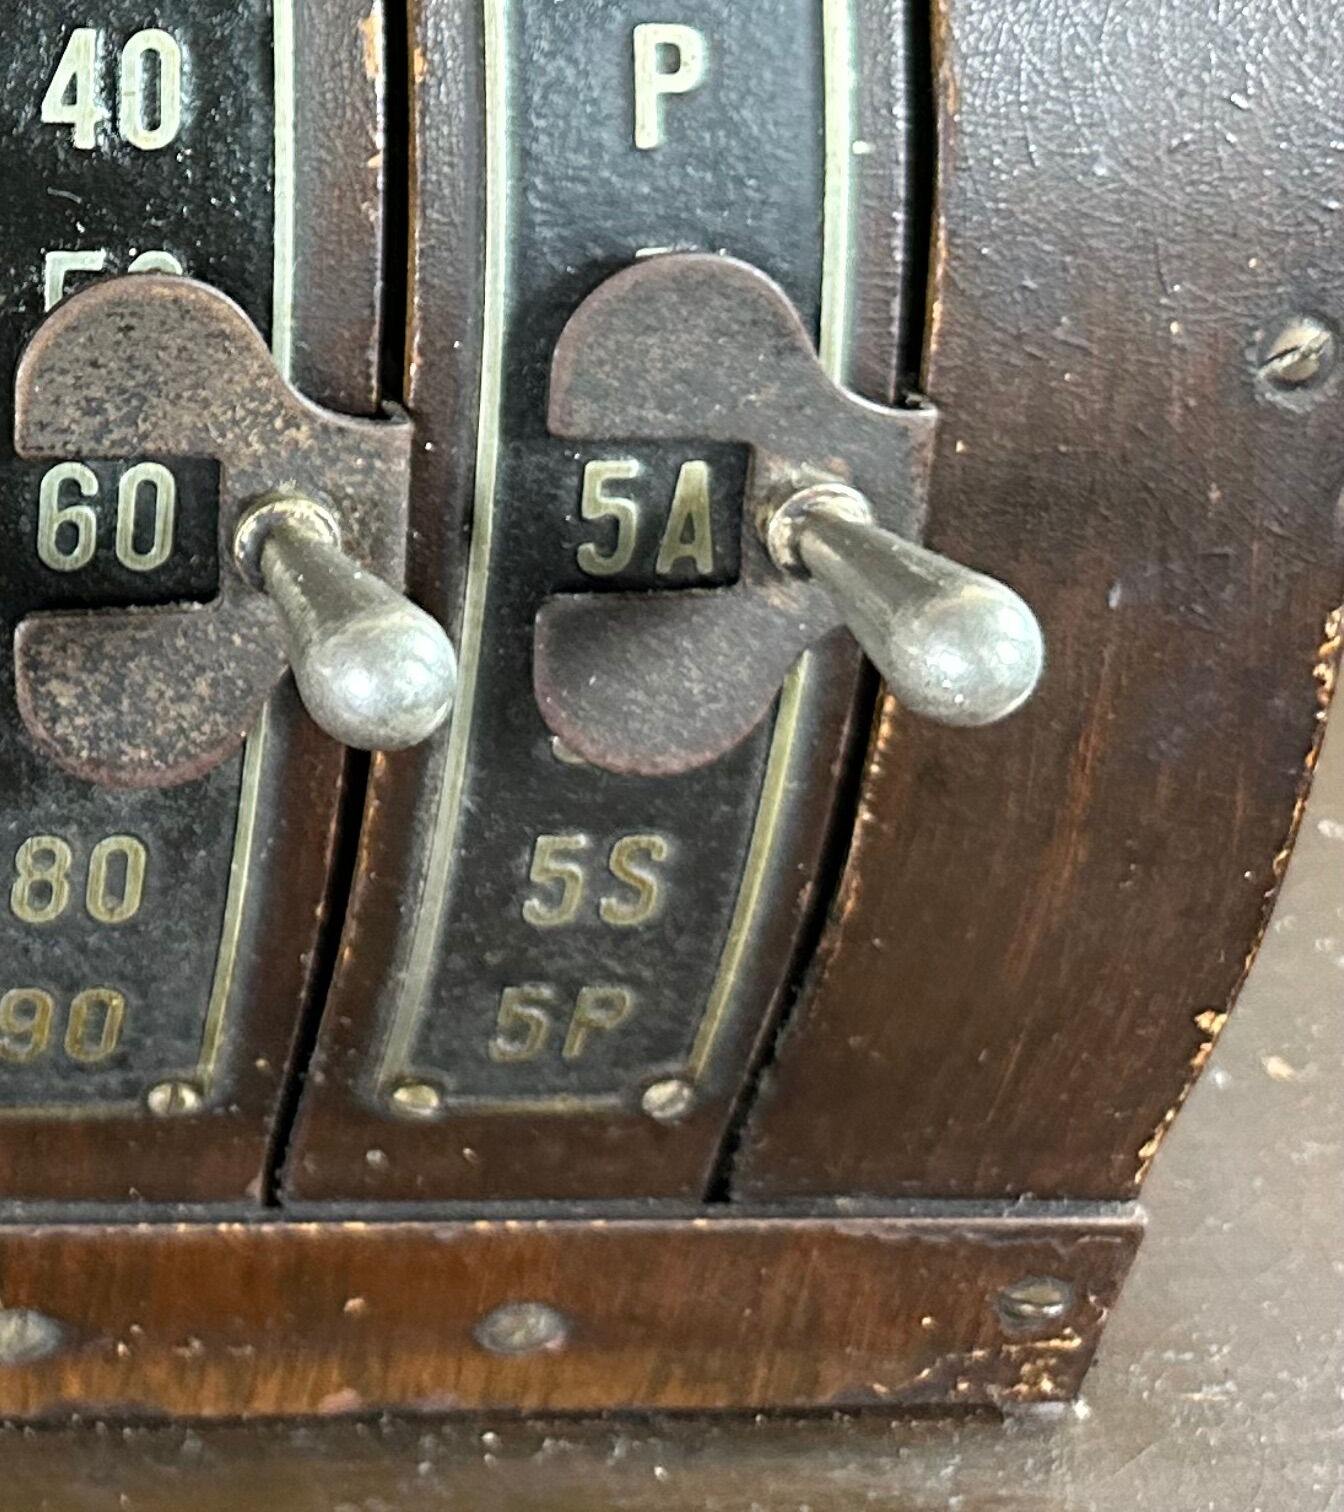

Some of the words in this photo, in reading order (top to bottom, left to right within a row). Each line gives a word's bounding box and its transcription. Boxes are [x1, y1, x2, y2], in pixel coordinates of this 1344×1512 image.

[40, 28, 181, 150] 40
[632, 22, 703, 150] P
[36, 461, 174, 573] 60
[577, 459, 710, 576] 5A
[10, 835, 146, 924] 80
[522, 834, 667, 926] 5S
[488, 984, 632, 1063] 5P
